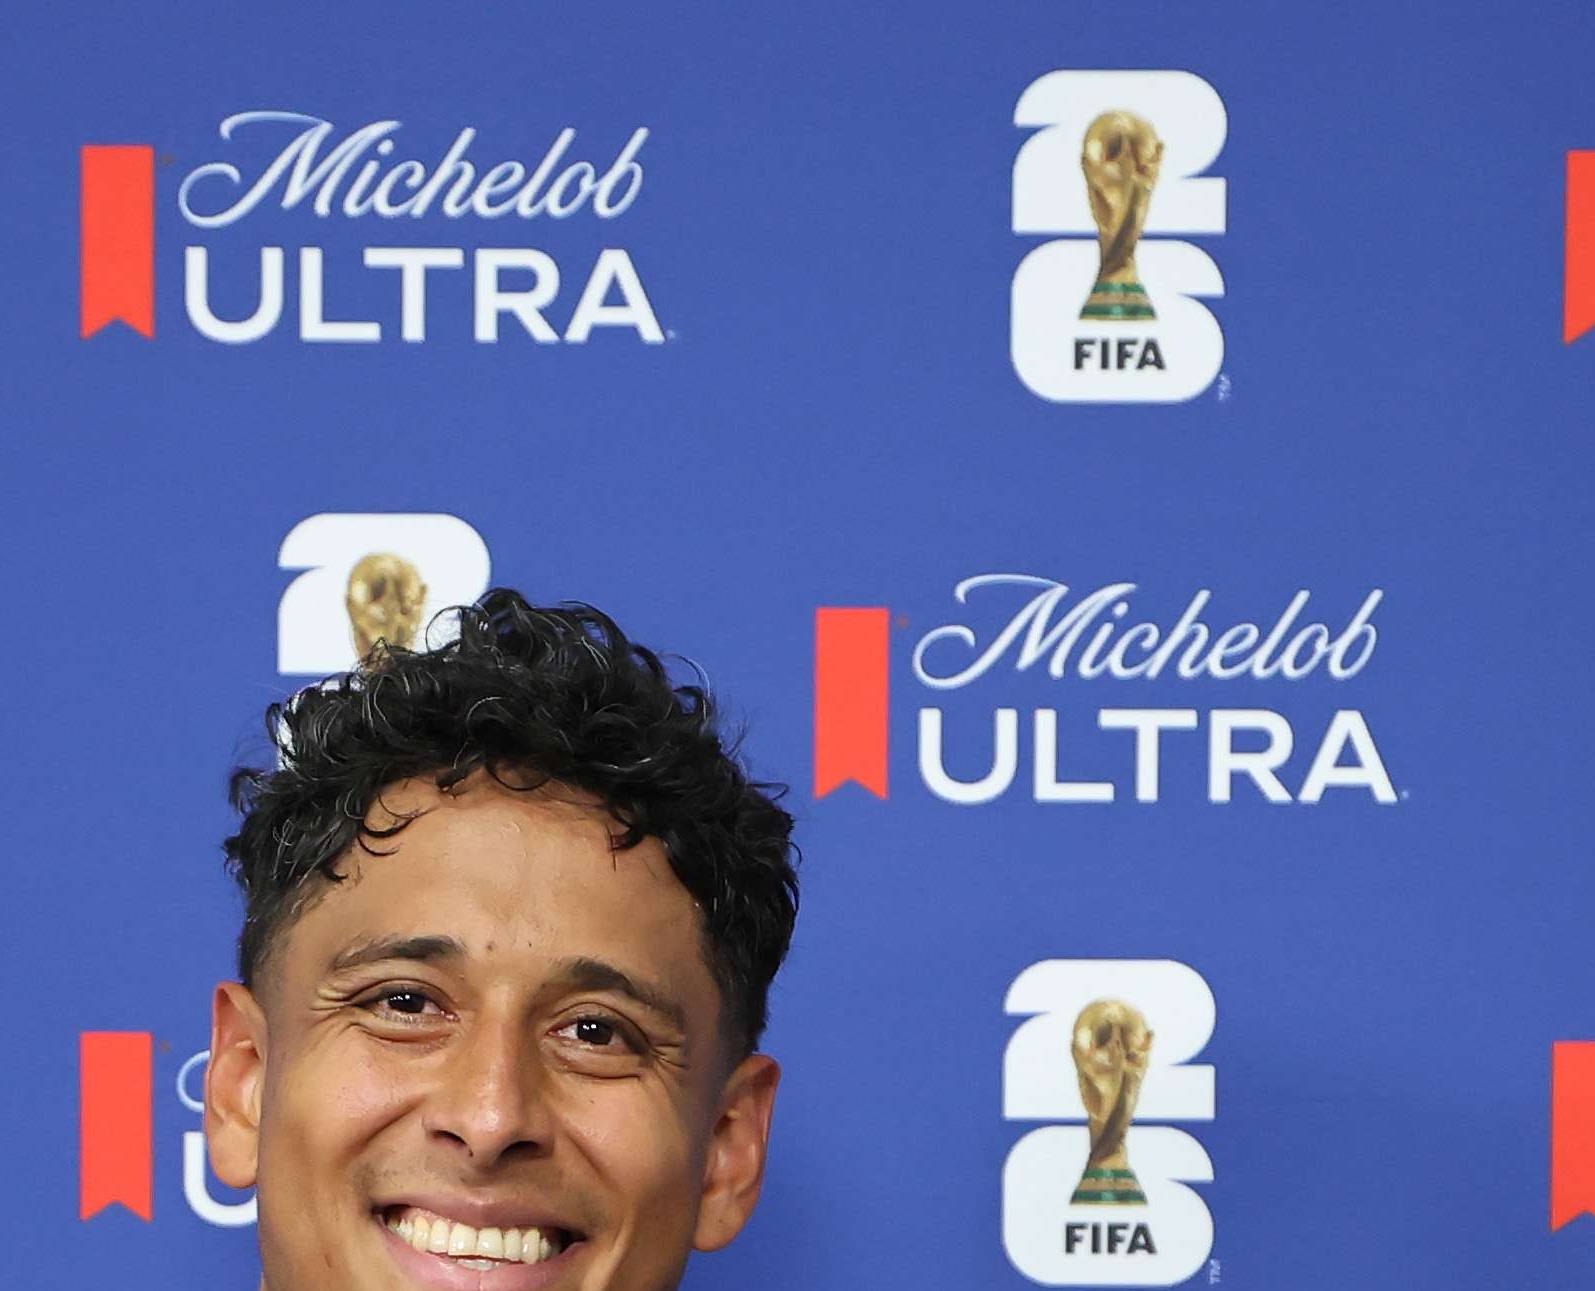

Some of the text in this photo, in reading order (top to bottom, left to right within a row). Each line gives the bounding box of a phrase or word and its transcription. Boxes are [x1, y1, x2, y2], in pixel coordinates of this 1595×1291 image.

[178, 111, 649, 228] Michelob
[184, 246, 665, 345] ULTRA
[1074, 338, 1166, 371] FIFA
[912, 573, 1383, 689] Michelob
[918, 707, 1398, 805] ULTRA
[1065, 1222, 1157, 1255] FIFA
